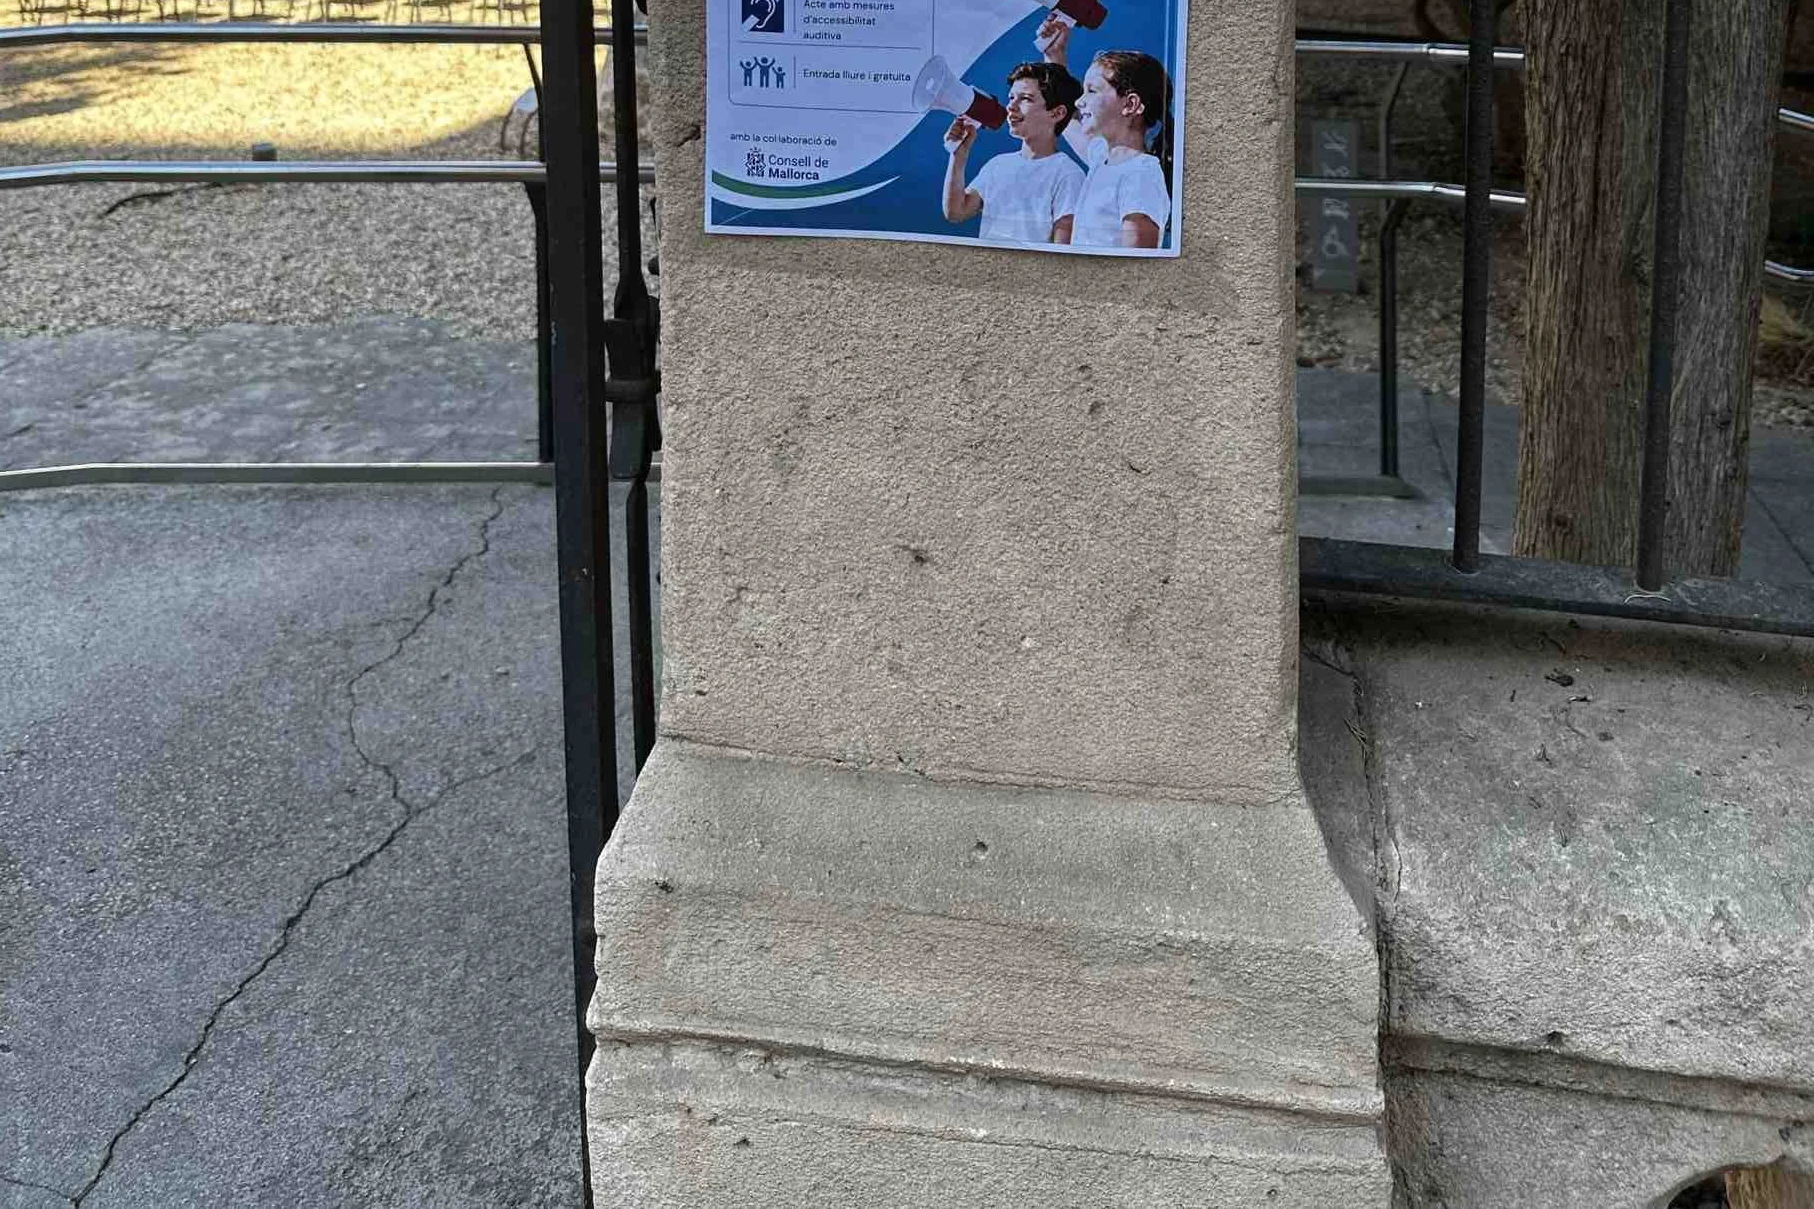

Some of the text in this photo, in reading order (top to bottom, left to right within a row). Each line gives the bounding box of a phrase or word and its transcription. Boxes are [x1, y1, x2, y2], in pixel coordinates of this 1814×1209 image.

[804, 0, 894, 11] Acte amb mesures
[803, 16, 876, 26] d'accessibilitat
[803, 31, 841, 40] auditiva
[803, 70, 840, 79] Entrada
[843, 71, 866, 80] lliure
[730, 133, 837, 146] amb la collaboració de
[769, 154, 829, 168] Consell de
[769, 168, 819, 180] Mallorca
